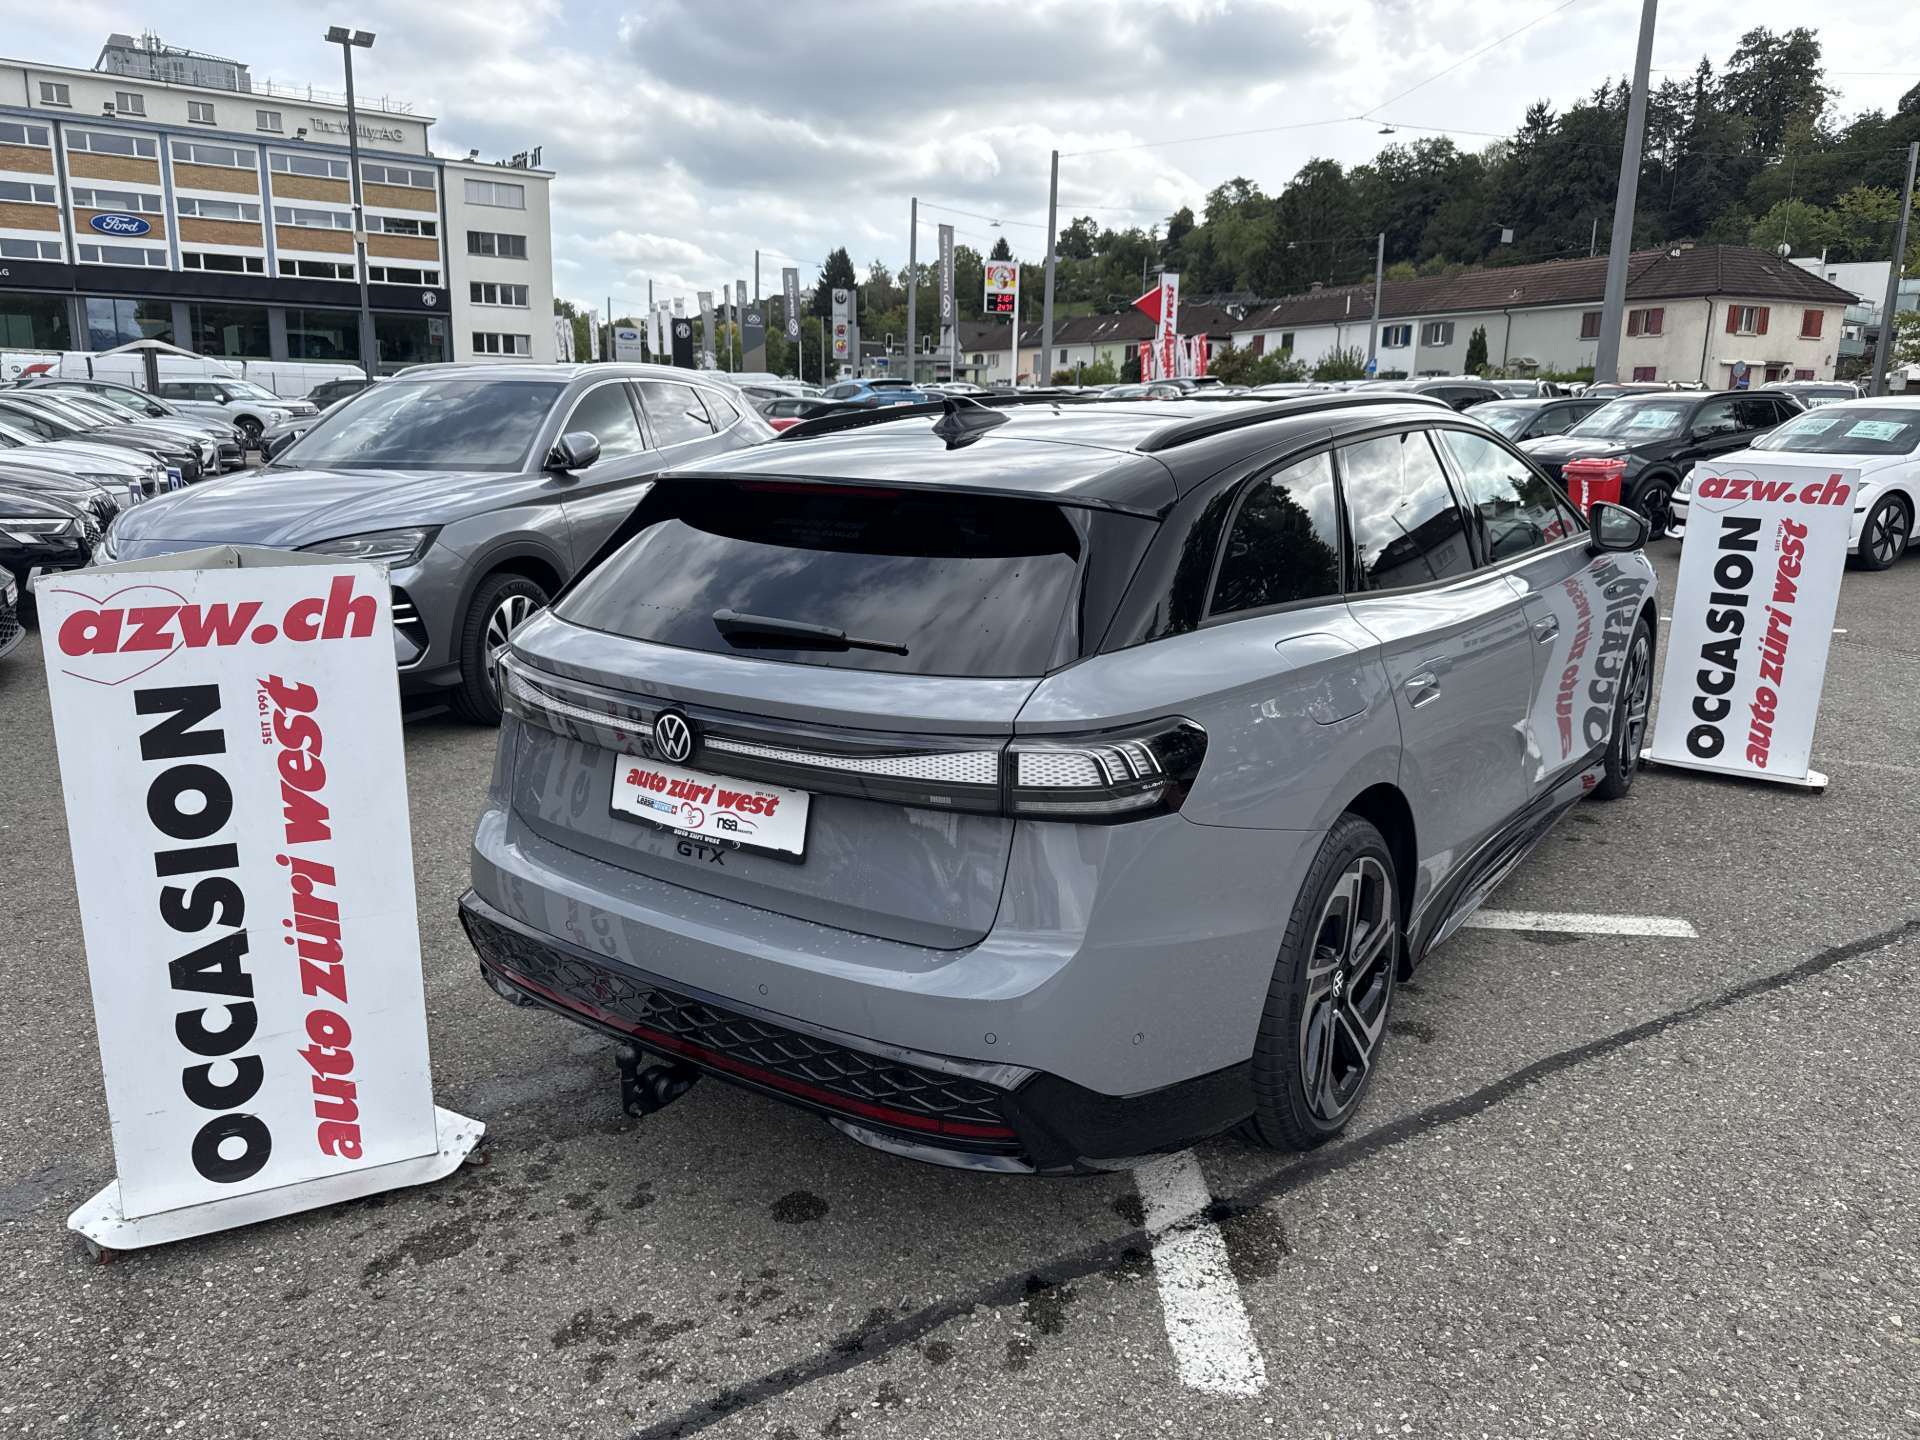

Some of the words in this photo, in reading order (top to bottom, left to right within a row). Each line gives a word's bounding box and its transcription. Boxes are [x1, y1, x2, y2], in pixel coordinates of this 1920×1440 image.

[102, 215, 139, 232] Ford
[1698, 474, 1850, 506] azw.ch
[1772, 518, 1808, 603] west
[57, 575, 377, 658] azw.ch
[1686, 516, 1762, 759] OCCASION
[1758, 604, 1792, 687] züri
[257, 689, 269, 716] 1991
[261, 721, 273, 745] SEIT
[1746, 686, 1778, 769] auto
[257, 674, 331, 843] west
[626, 768, 667, 793] auto
[667, 778, 716, 805] züri
[717, 789, 780, 817] west
[677, 840, 725, 866] GTX
[717, 816, 737, 832] nsa
[133, 683, 273, 1184] OCCASION
[275, 853, 348, 1003] züri
[296, 1009, 363, 1160] auto
